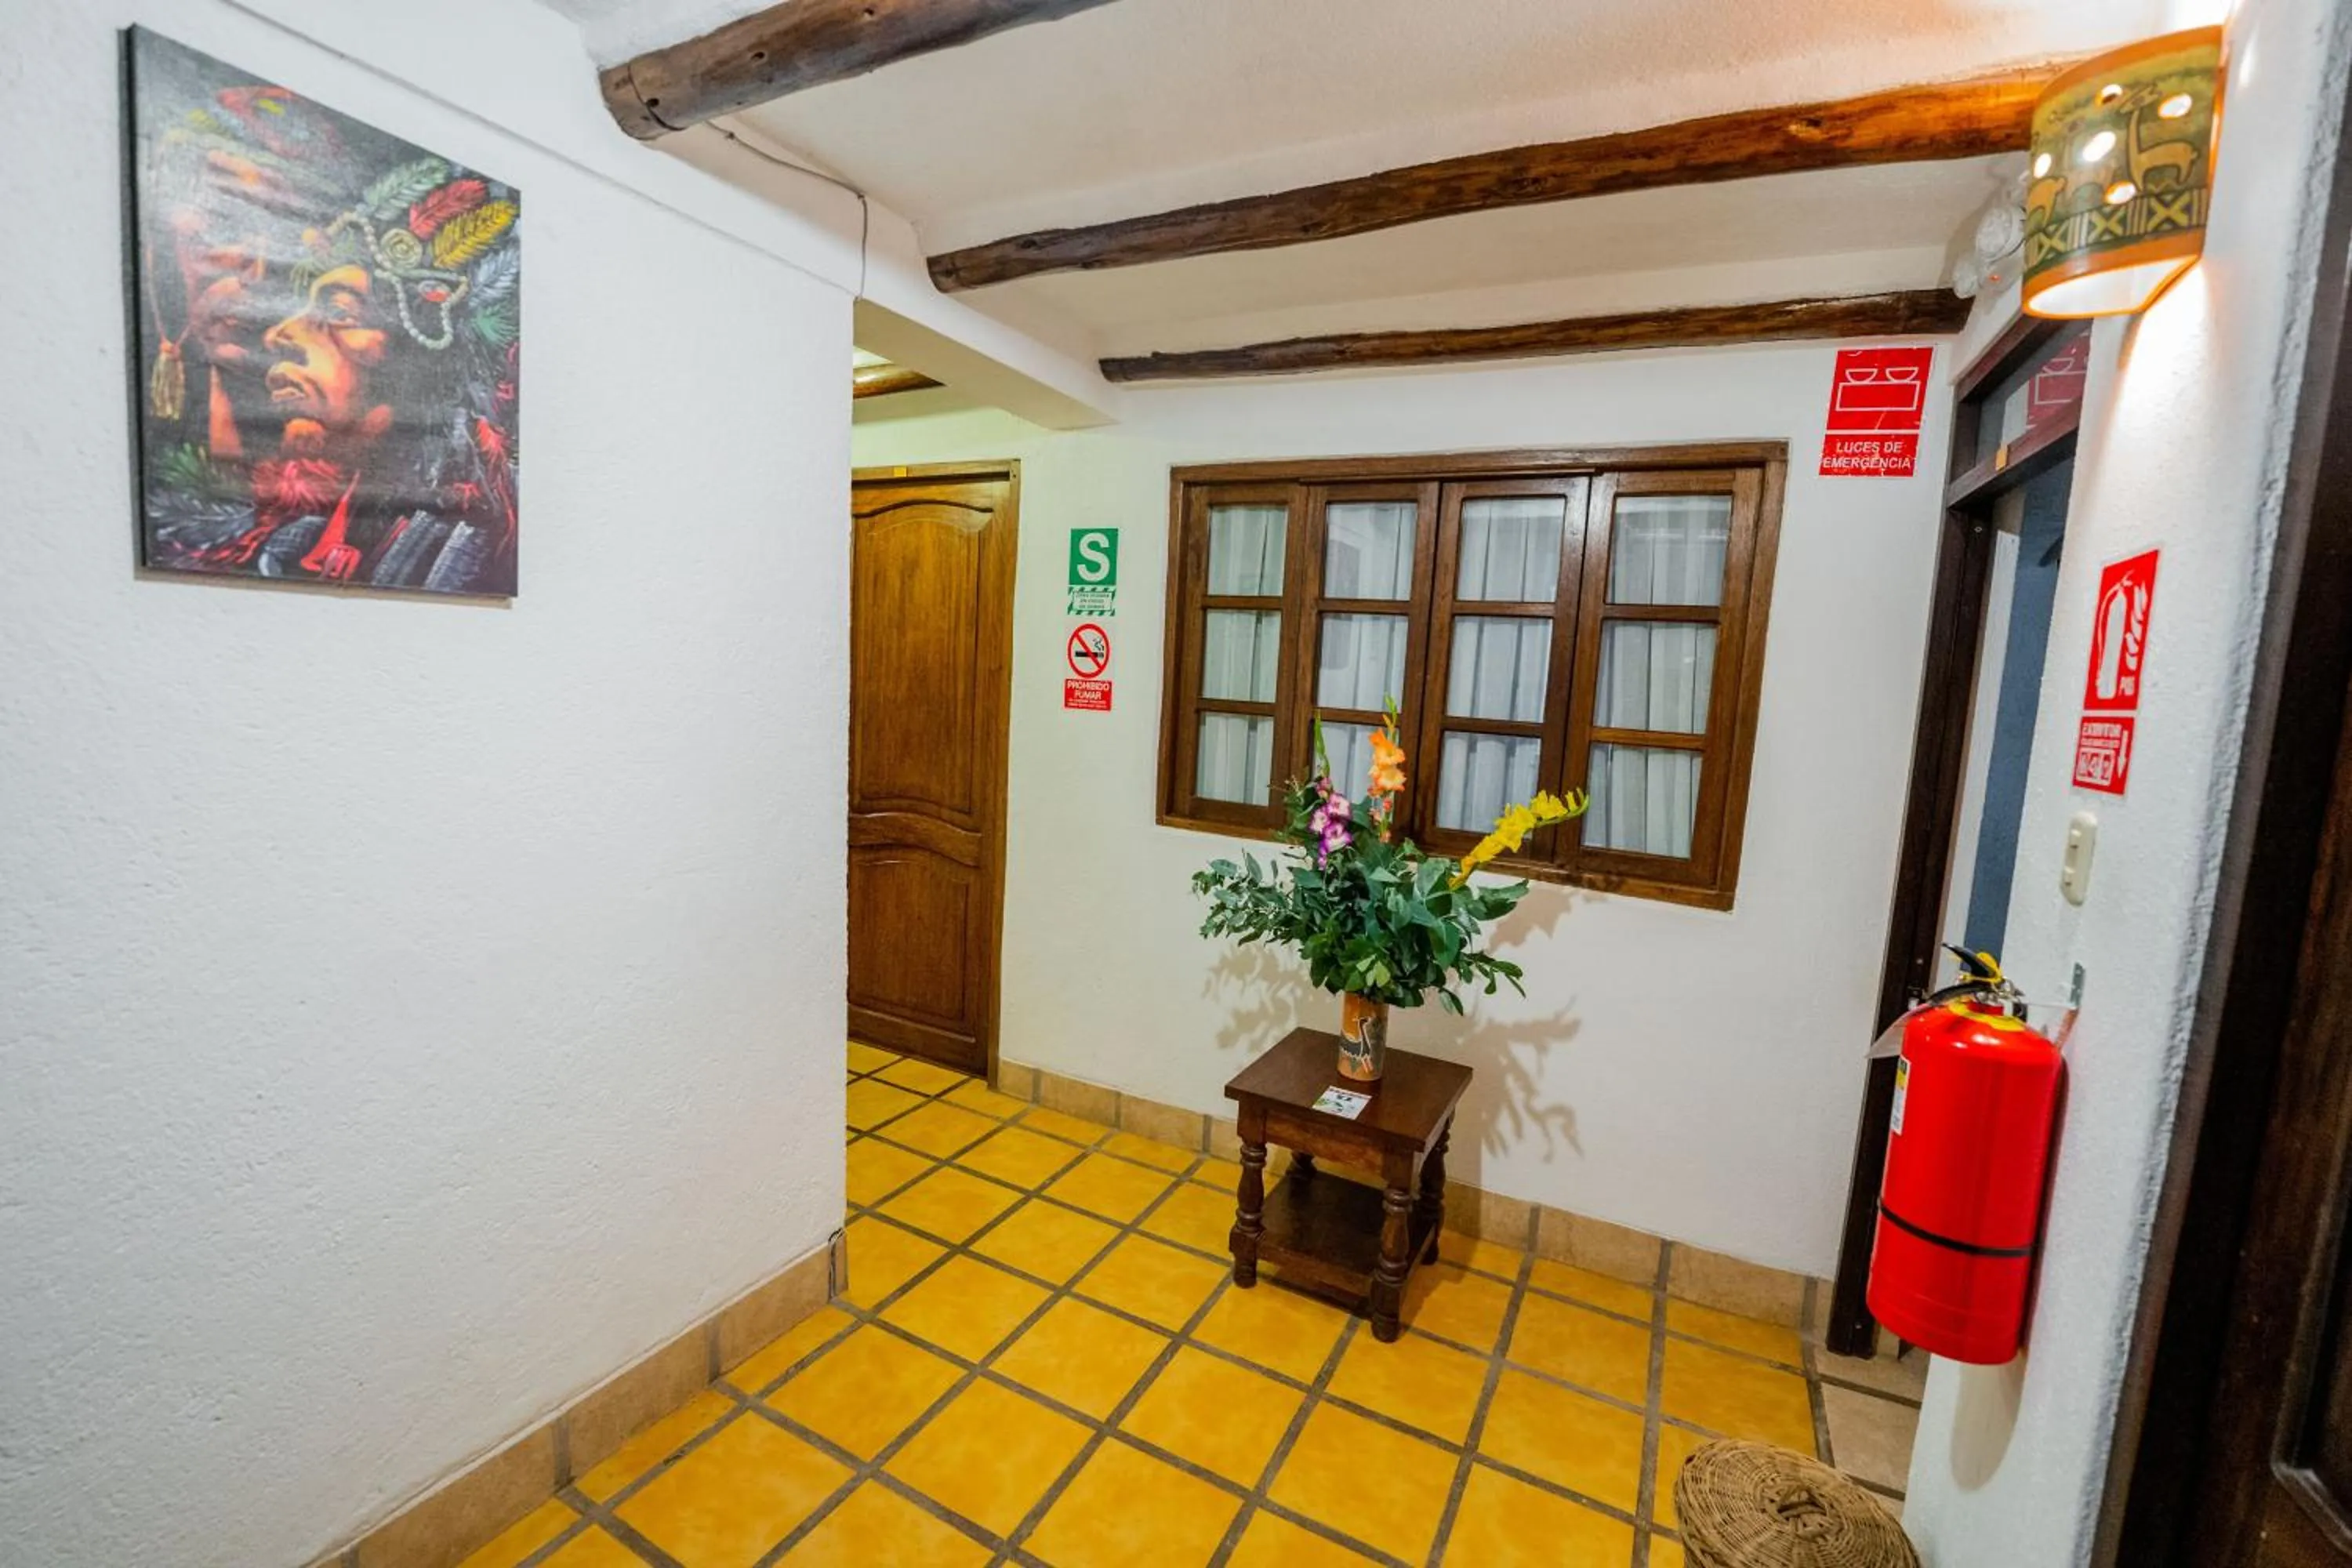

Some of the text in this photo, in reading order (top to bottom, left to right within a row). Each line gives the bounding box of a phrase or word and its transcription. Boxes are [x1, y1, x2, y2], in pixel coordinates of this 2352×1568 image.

[1836, 441, 1903, 452] LUCES DE
[1823, 457, 1911, 468] EMERGENCIA
[1077, 532, 1110, 582] S
[1067, 680, 1109, 691] PROHIBIDO
[1075, 690, 1102, 700] FUMAR
